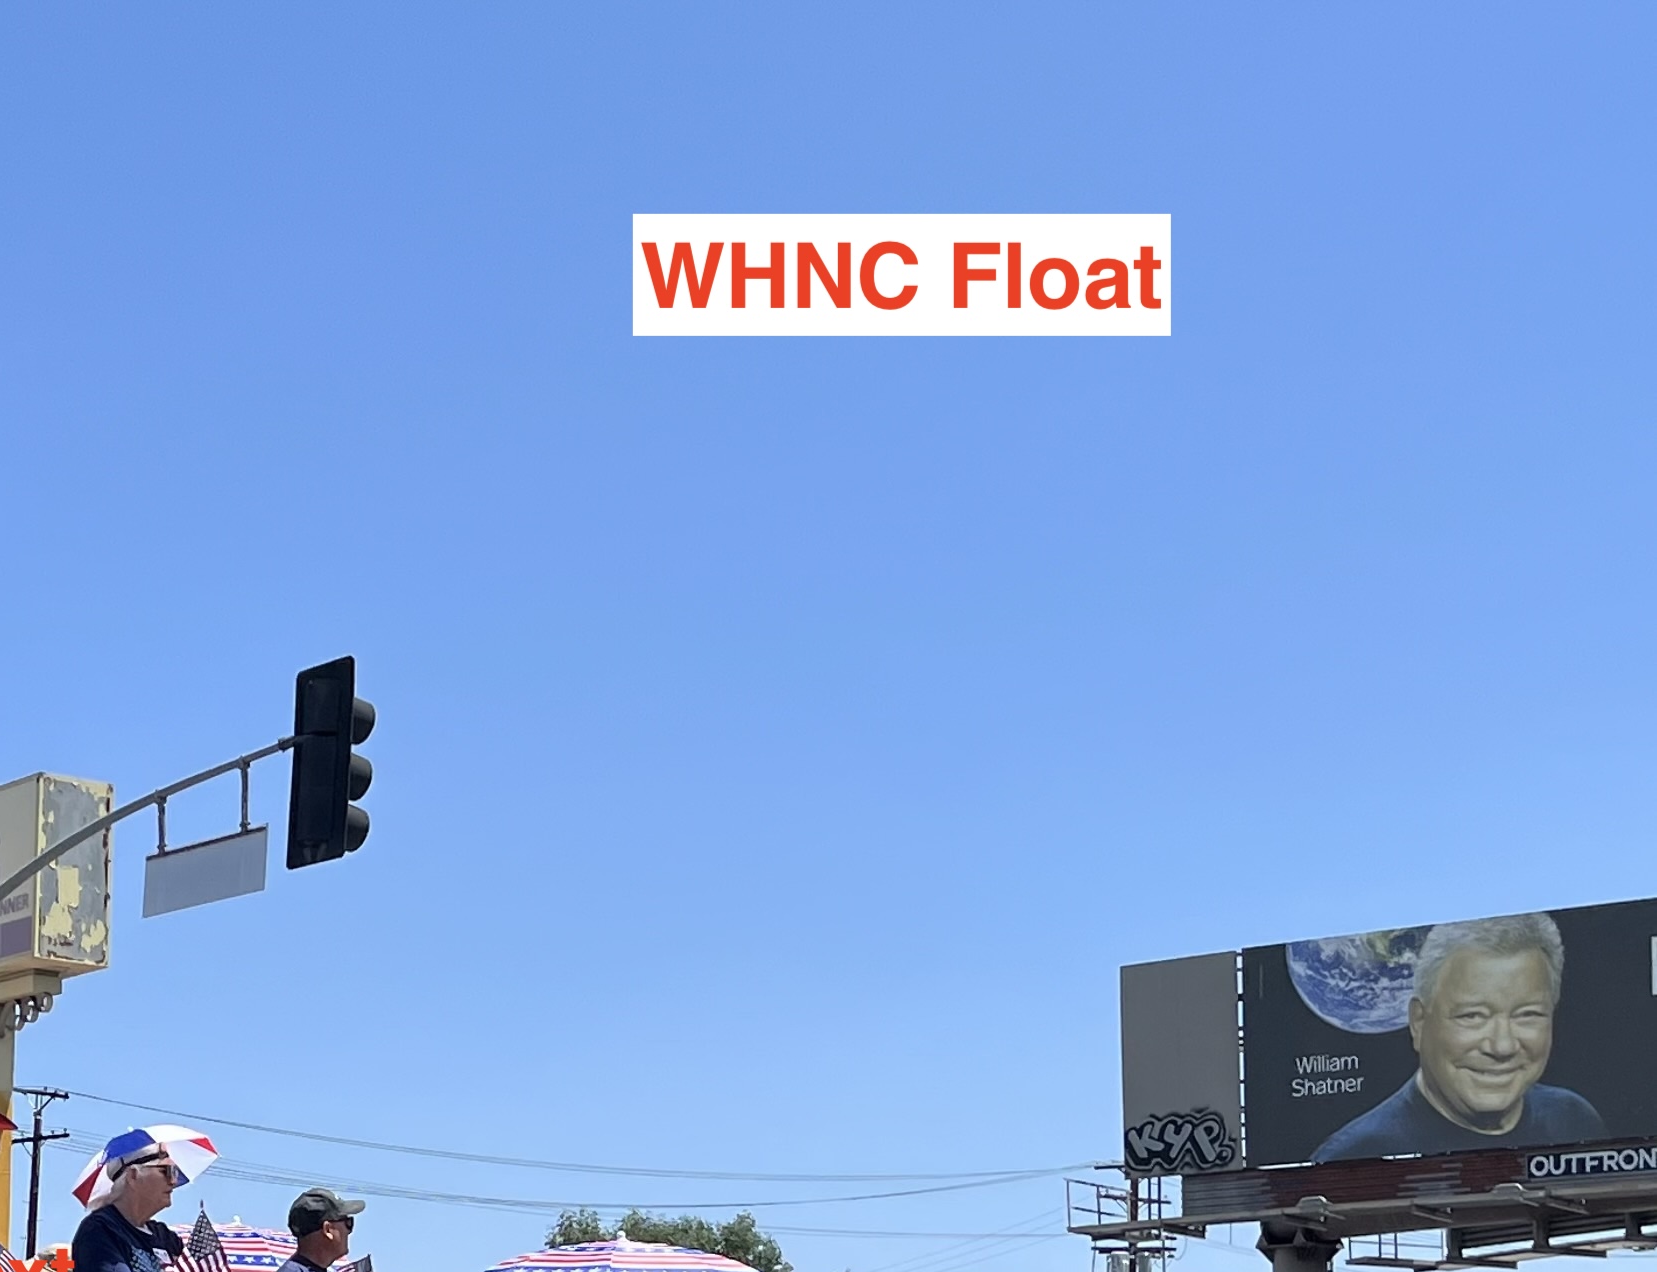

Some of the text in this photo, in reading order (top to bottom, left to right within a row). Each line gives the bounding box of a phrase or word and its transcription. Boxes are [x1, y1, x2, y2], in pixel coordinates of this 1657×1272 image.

[1294, 1054, 1359, 1075] William
[1290, 1076, 1365, 1098] Shatner
[1529, 1147, 1657, 1177] OUTFRON
